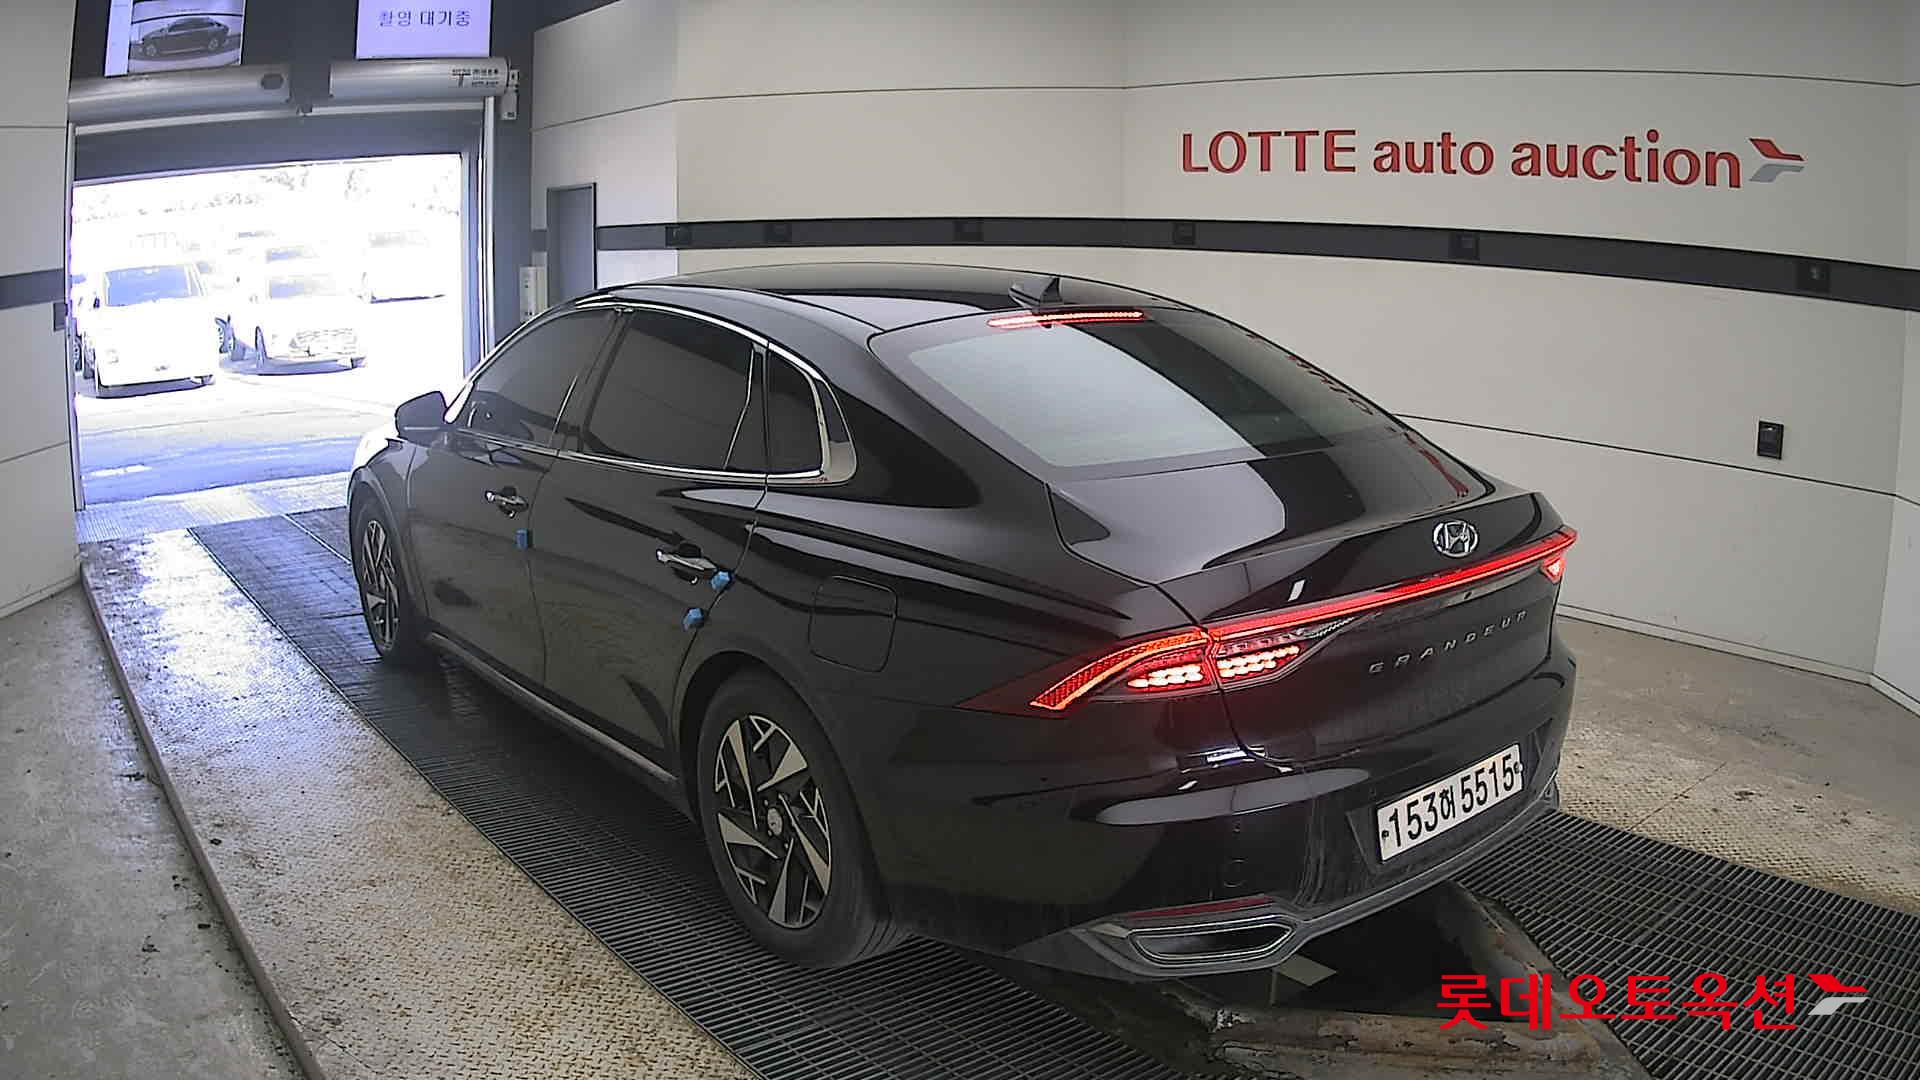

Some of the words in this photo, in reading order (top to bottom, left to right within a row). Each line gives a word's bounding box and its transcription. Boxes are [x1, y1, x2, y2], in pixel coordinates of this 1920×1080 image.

[420, 10, 470, 27] 대기중
[1182, 129, 1357, 174] LOTTE
[1372, 131, 1495, 177] auto
[1510, 129, 1743, 189] auction
[1368, 610, 1527, 673] GRANDEUR
[1460, 753, 1515, 814] 5515
